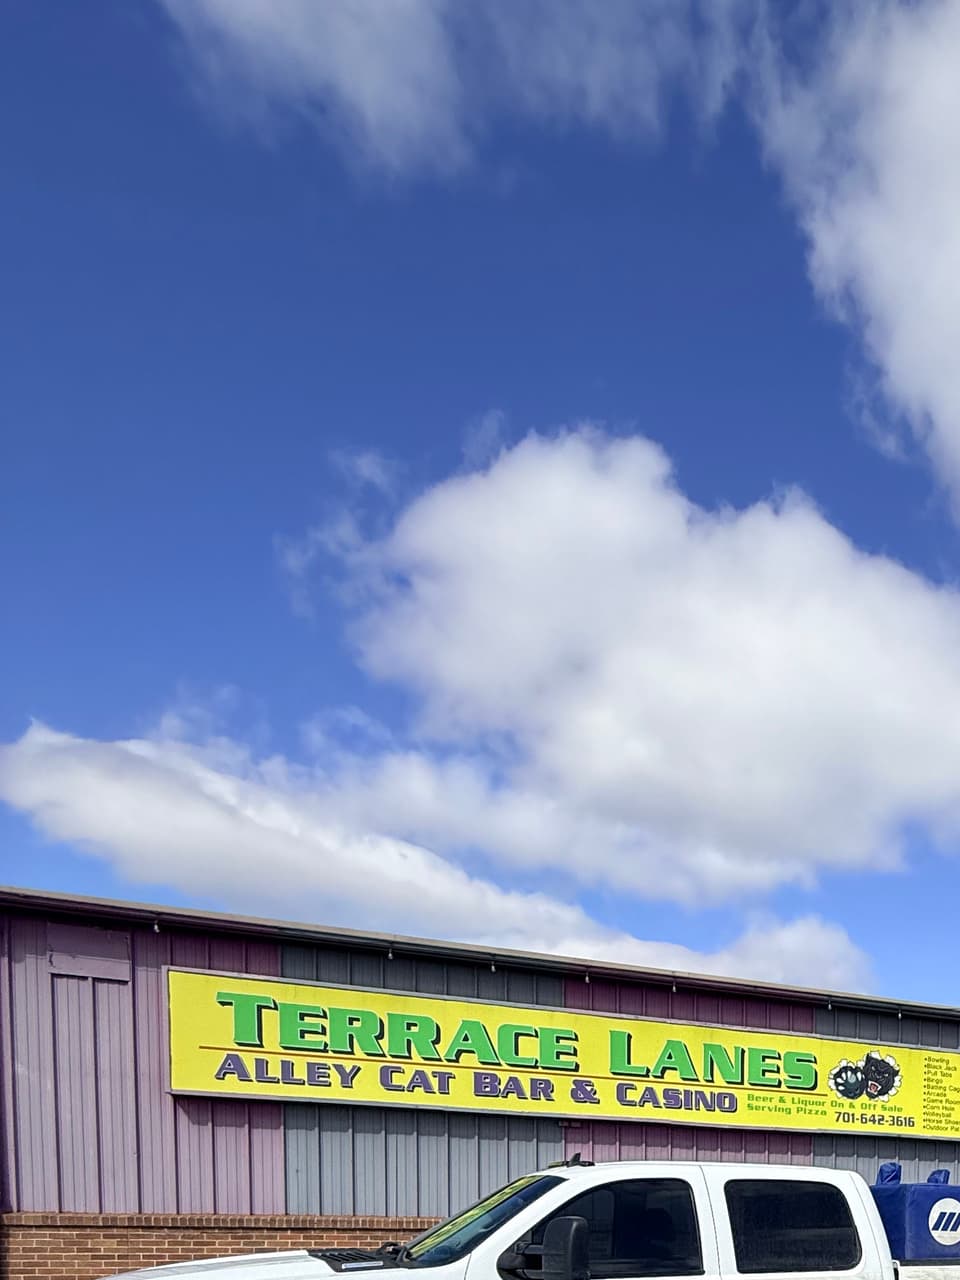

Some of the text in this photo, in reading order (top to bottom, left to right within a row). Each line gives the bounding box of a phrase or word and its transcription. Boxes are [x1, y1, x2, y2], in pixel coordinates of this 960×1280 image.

[215, 991, 819, 1091] TERRACE LANES
[215, 1053, 738, 1114] ALLEY CAT BAR & CASINO
[747, 1093, 904, 1113] Beer & Liquor On & Off Sale
[747, 1103, 828, 1116] Serving Pizza
[834, 1111, 916, 1128] 701-642-3616
